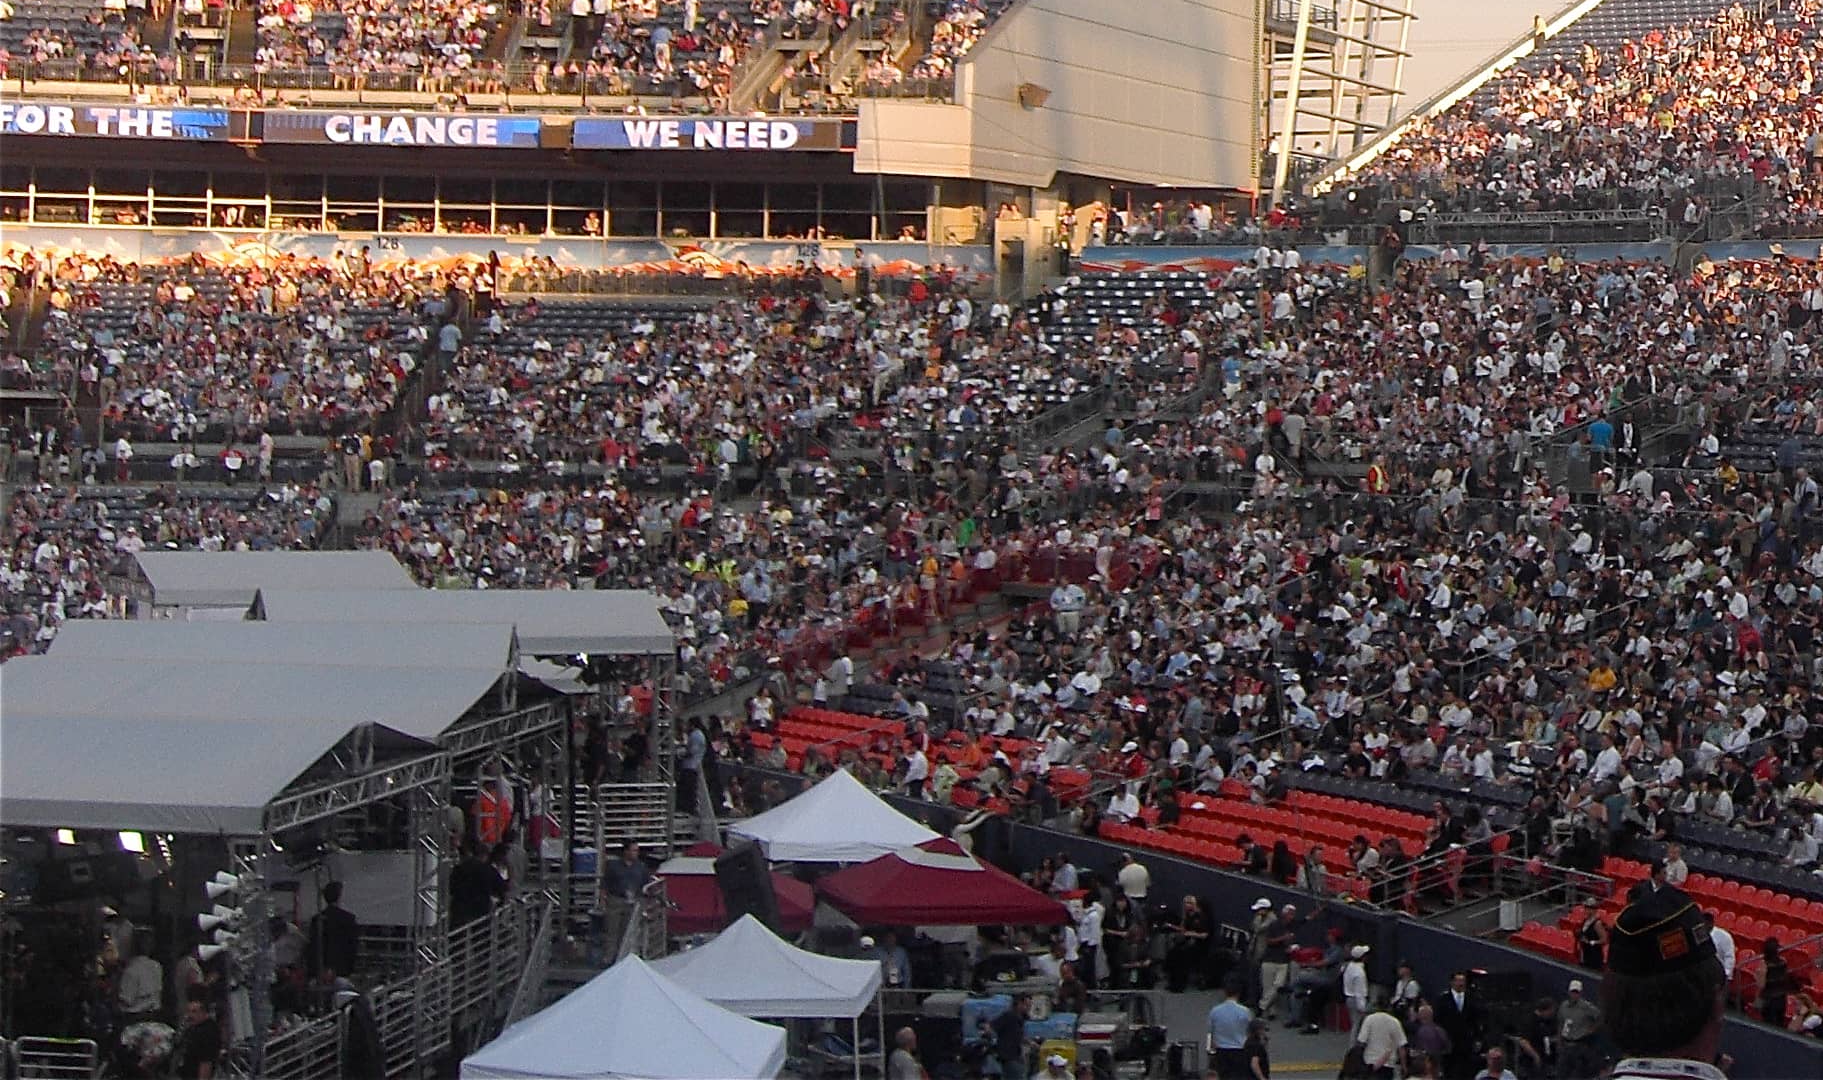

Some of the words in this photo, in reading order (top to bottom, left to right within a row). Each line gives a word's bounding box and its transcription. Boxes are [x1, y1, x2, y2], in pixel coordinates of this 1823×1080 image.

[0, 105, 75, 134] FOR
[87, 107, 173, 137] THE
[324, 115, 499, 145] CHANGE
[623, 120, 681, 148] WE
[694, 120, 799, 149] NEED
[376, 236, 400, 251] 128
